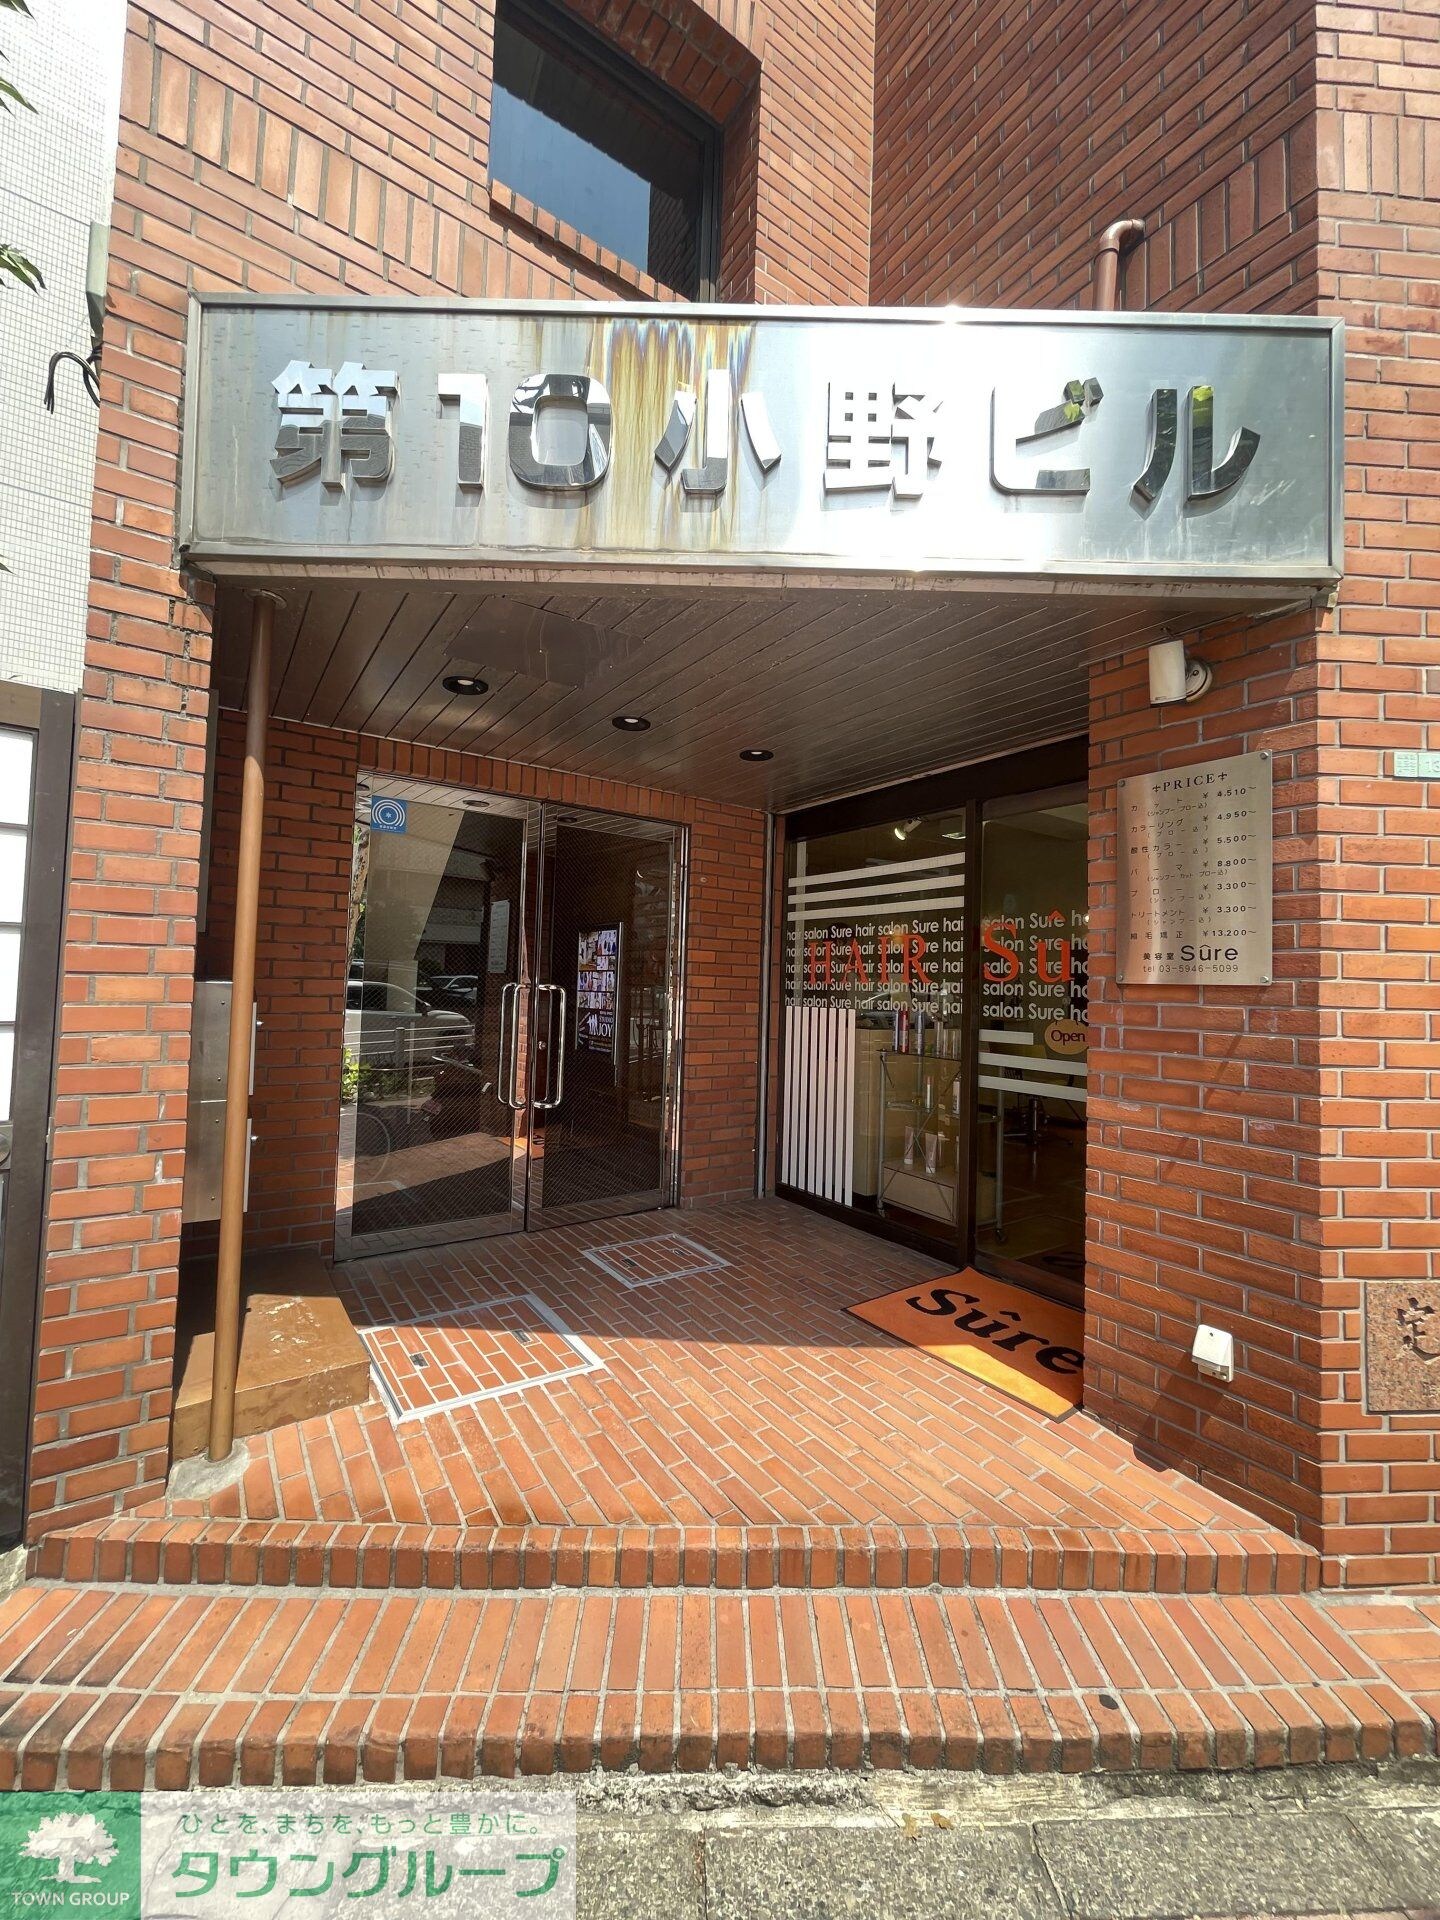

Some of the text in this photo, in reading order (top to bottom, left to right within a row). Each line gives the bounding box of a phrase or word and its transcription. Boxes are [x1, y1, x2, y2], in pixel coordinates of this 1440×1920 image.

[269, 359, 1261, 500] 第10小野ビル
[1163, 773, 1215, 792] PRICE
[1131, 818, 1184, 833] カラーリング
[1131, 910, 1185, 919] トリートメント
[804, 927, 828, 940] salon
[831, 925, 852, 939] Sure
[855, 923, 876, 937] hair
[878, 921, 909, 936] salon
[912, 919, 940, 934] Sure
[803, 944, 828, 957] saon
[831, 943, 852, 956] Sure
[911, 939, 939, 954] Sre
[983, 937, 1025, 952] lon
[1029, 935, 1063, 952] Sre
[1144, 944, 1239, 961] 美容室 Sûre
[803, 962, 828, 974] saon
[1029, 957, 1063, 975] Sre
[807, 934, 932, 984] HAIR
[1160, 964, 1239, 973] 03-5946-5099
[830, 978, 852, 991] Sure
[877, 978, 909, 993] salon
[911, 978, 939, 993] Sure
[982, 981, 1024, 997] salon
[1028, 980, 1066, 998] Sure
[803, 995, 828, 1007] salon
[830, 995, 852, 1010] Sure
[855, 995, 875, 1010] hair
[877, 997, 908, 1012] salon
[911, 997, 939, 1013] Sure
[982, 1001, 1024, 1019] salon
[1028, 1002, 1065, 1021] Sure
[1051, 1029, 1086, 1045] Open
[905, 1289, 1084, 1374] Sûre
